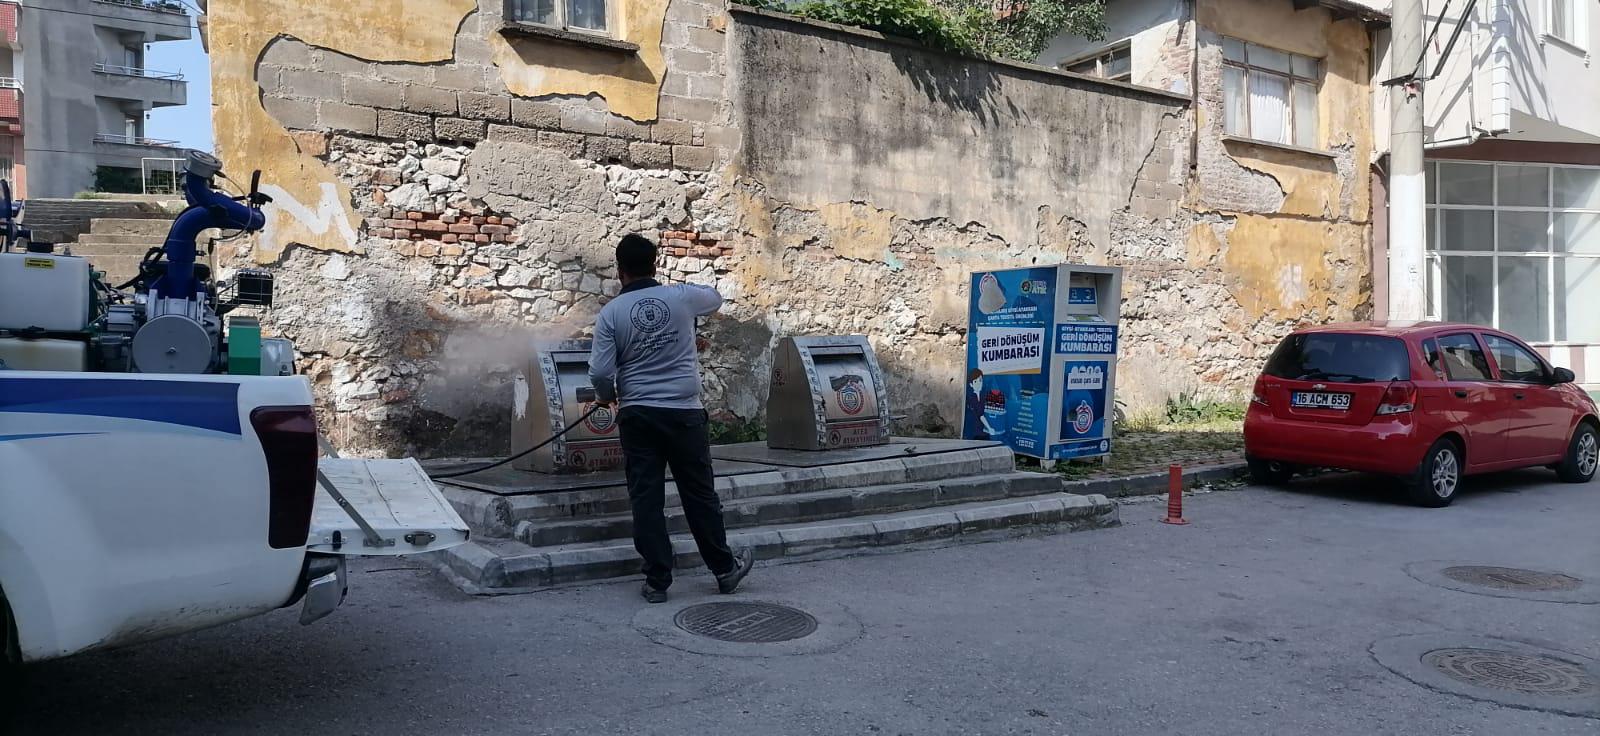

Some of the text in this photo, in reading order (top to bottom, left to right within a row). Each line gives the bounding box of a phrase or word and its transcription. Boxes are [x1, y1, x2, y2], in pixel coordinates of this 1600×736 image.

[981, 332, 1040, 348] GERİ DÖNÜŞÜM
[1061, 332, 1113, 343] GERİ DÖNÜŞÜM
[981, 345, 1040, 362] KUMBARASI
[1060, 342, 1113, 352] KUMBARASI
[1298, 393, 1350, 406] 16 ACM 653
